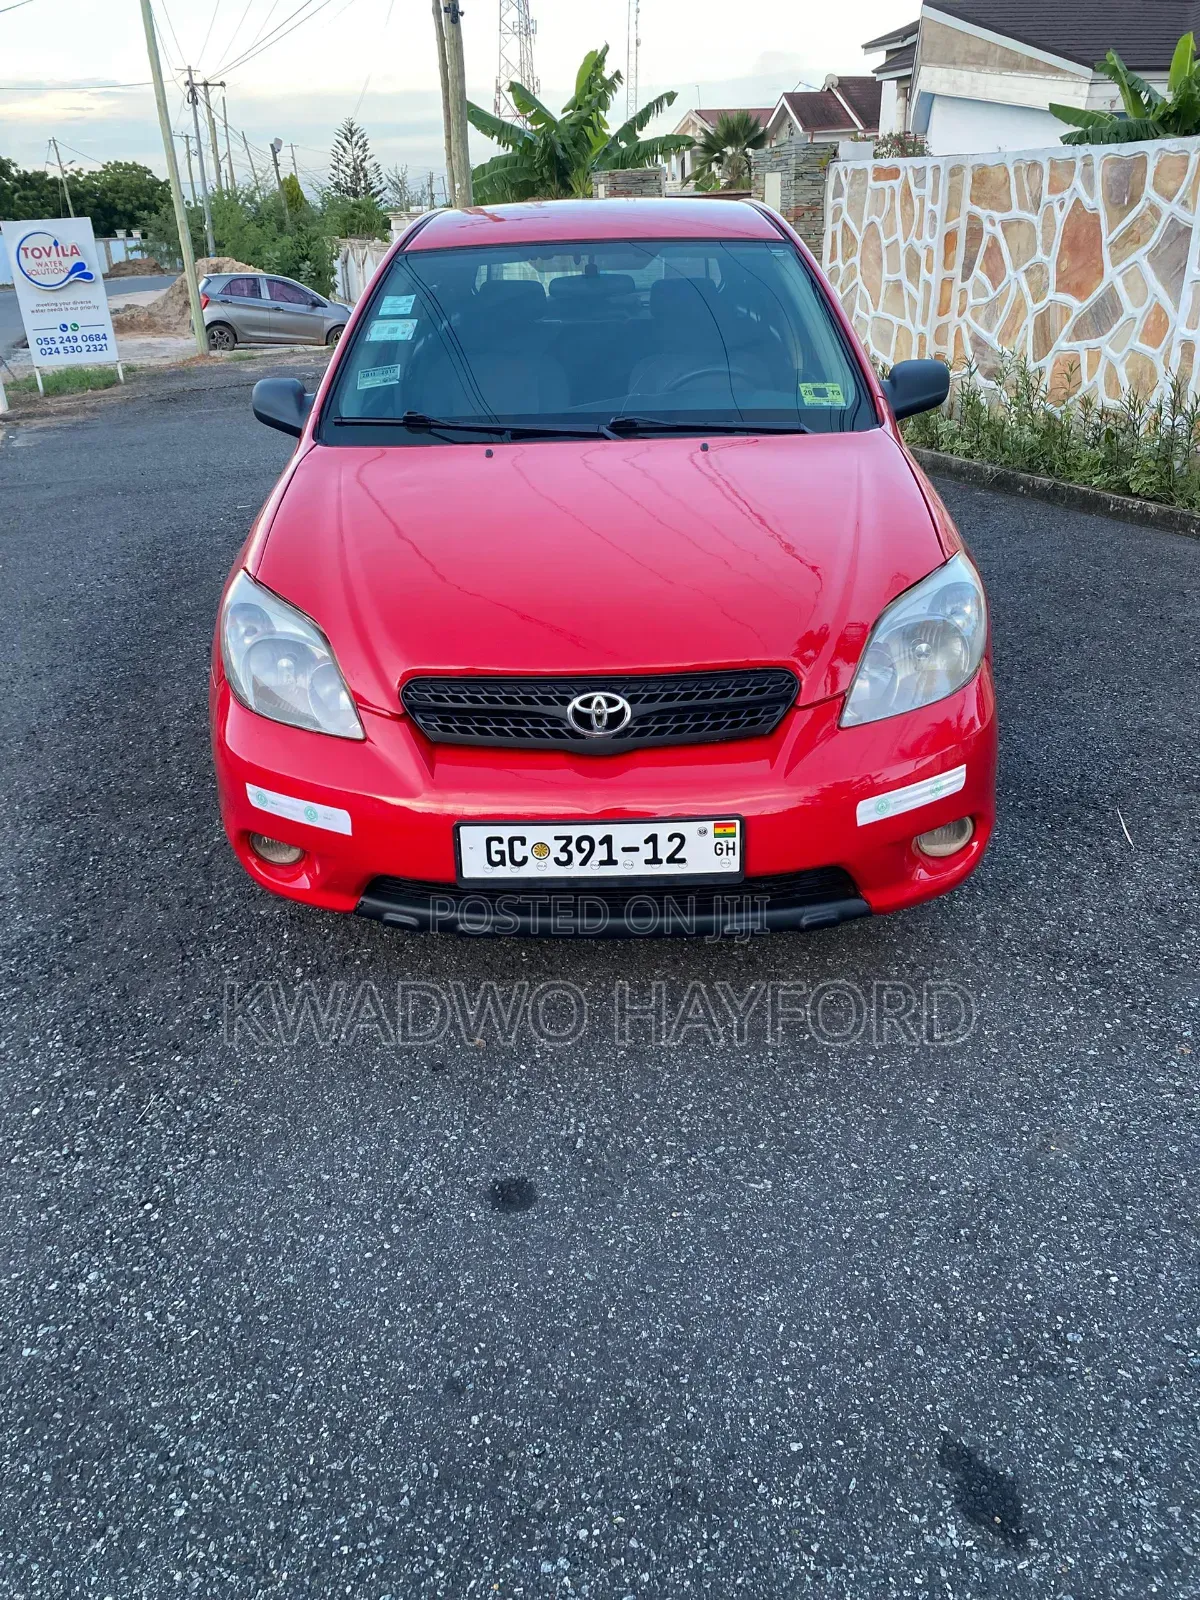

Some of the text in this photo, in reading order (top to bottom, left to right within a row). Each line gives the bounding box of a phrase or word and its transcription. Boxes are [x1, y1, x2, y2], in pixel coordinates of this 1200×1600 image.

[21, 244, 81, 259] TOVILA
[36, 260, 63, 268] WATER
[27, 267, 69, 277] SOLUTIONS
[36, 333, 107, 345] 055 249 0684
[40, 343, 108, 356] 024 530 2321
[485, 832, 687, 868] GC 391-12
[714, 840, 736, 857] GH
